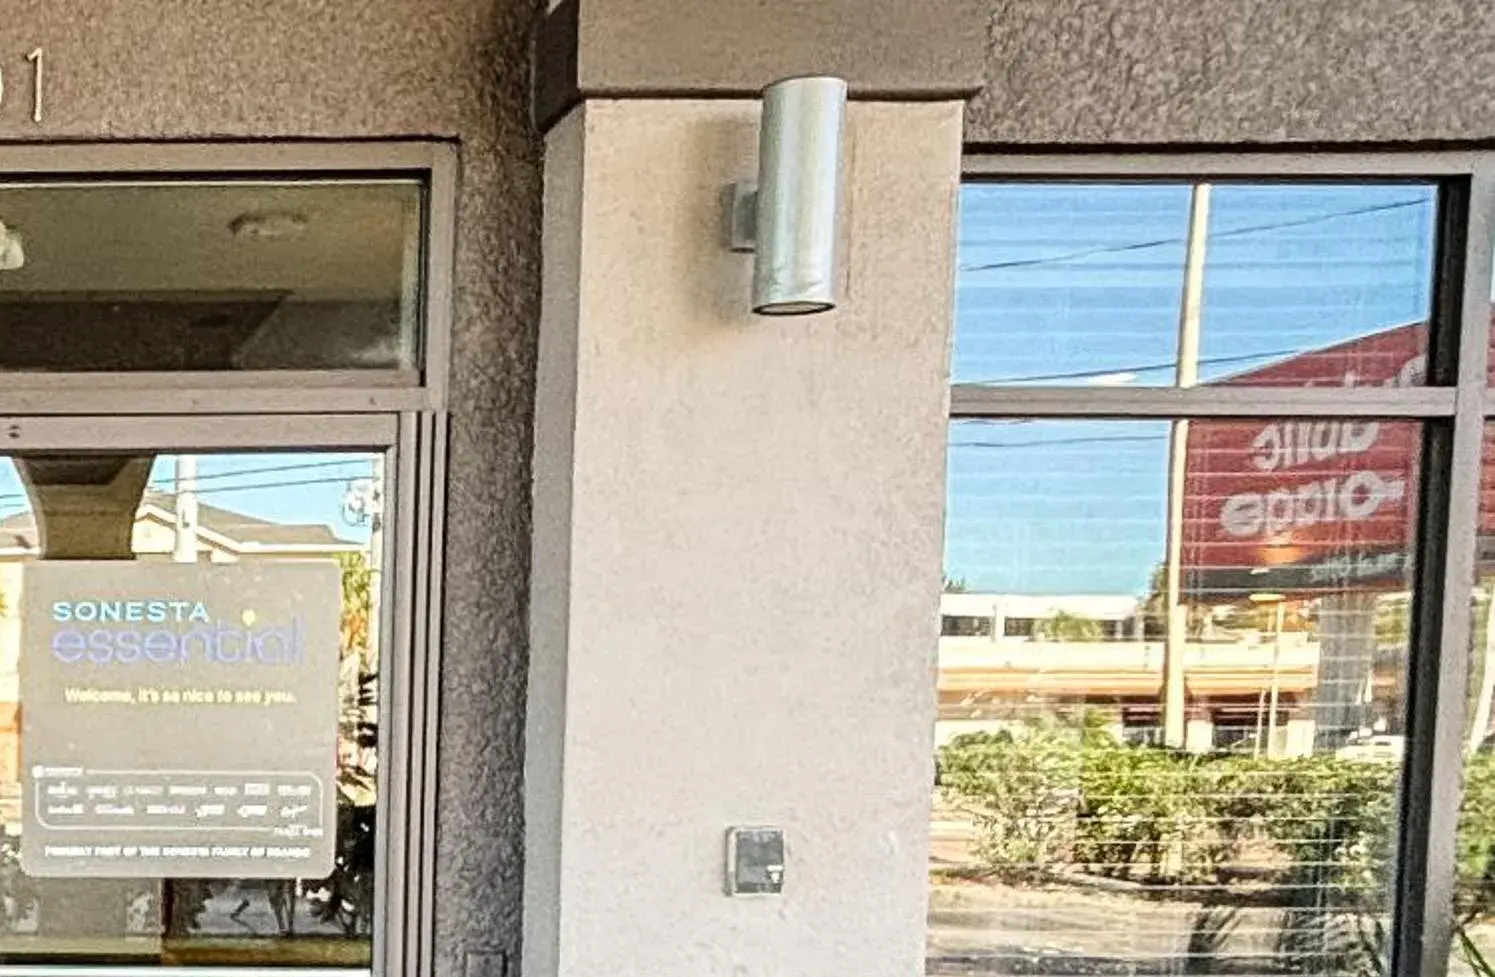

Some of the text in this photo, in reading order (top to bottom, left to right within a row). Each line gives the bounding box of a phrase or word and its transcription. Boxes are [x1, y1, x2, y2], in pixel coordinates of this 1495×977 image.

[52, 601, 210, 623] SONESTA
[52, 609, 305, 664] essential
[64, 687, 136, 705] Welcome,
